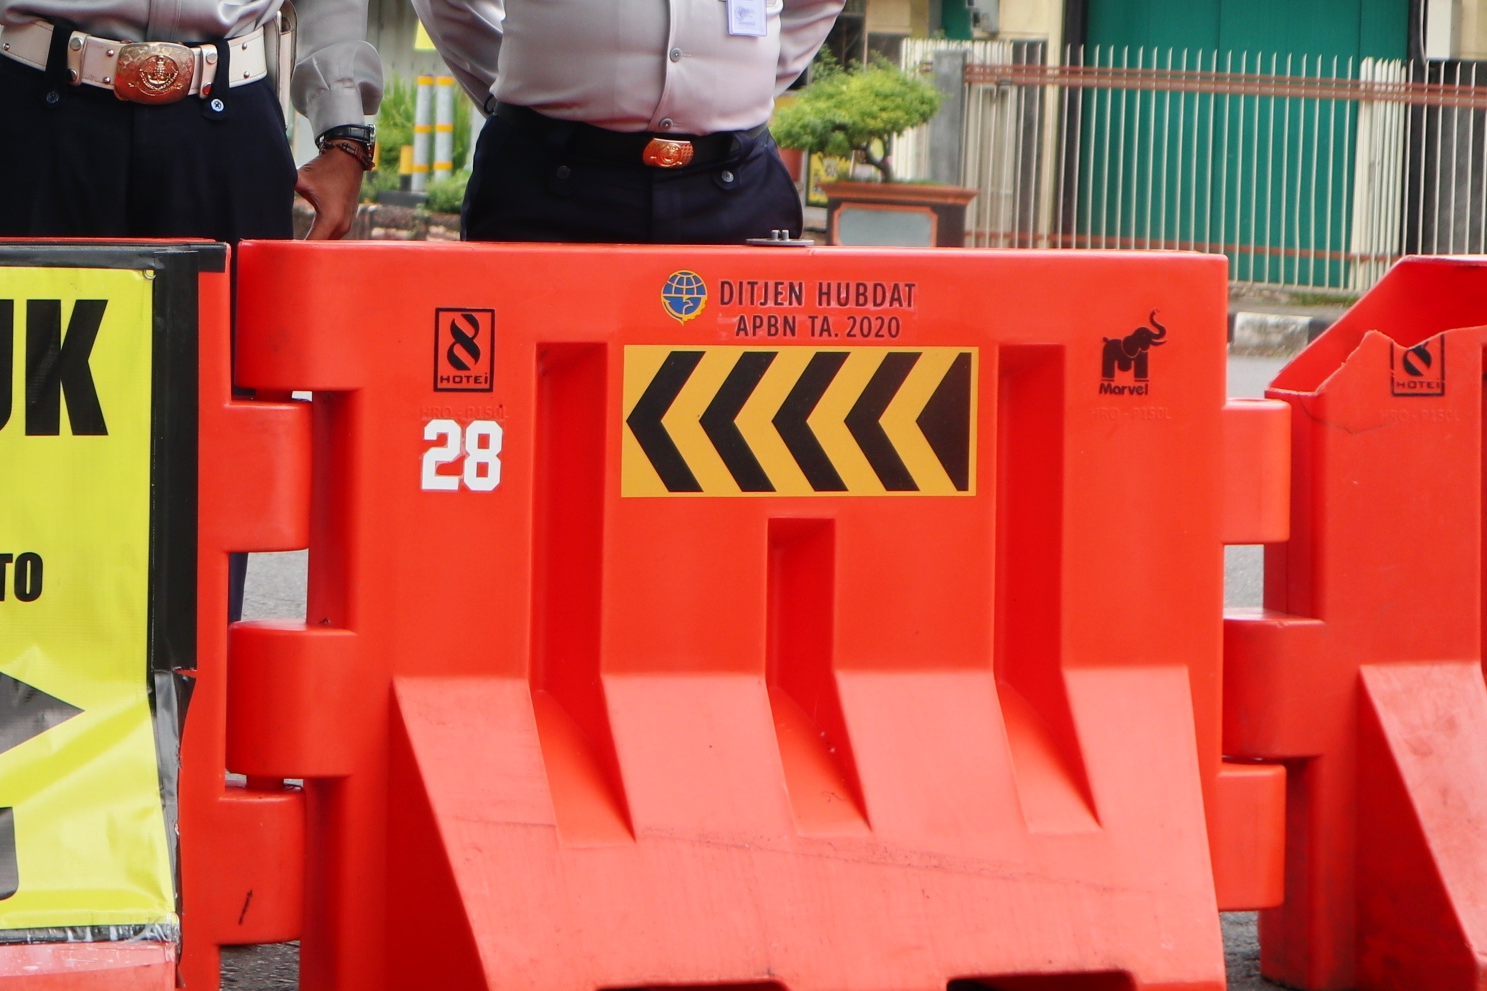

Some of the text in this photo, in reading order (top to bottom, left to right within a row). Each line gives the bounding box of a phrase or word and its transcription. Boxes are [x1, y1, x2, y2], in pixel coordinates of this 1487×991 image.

[719, 280, 916, 308] DITJEN HUBDAT
[735, 314, 900, 339] APBN TA. 2020
[1099, 382, 1149, 396] Marvel
[421, 418, 503, 492] 28
